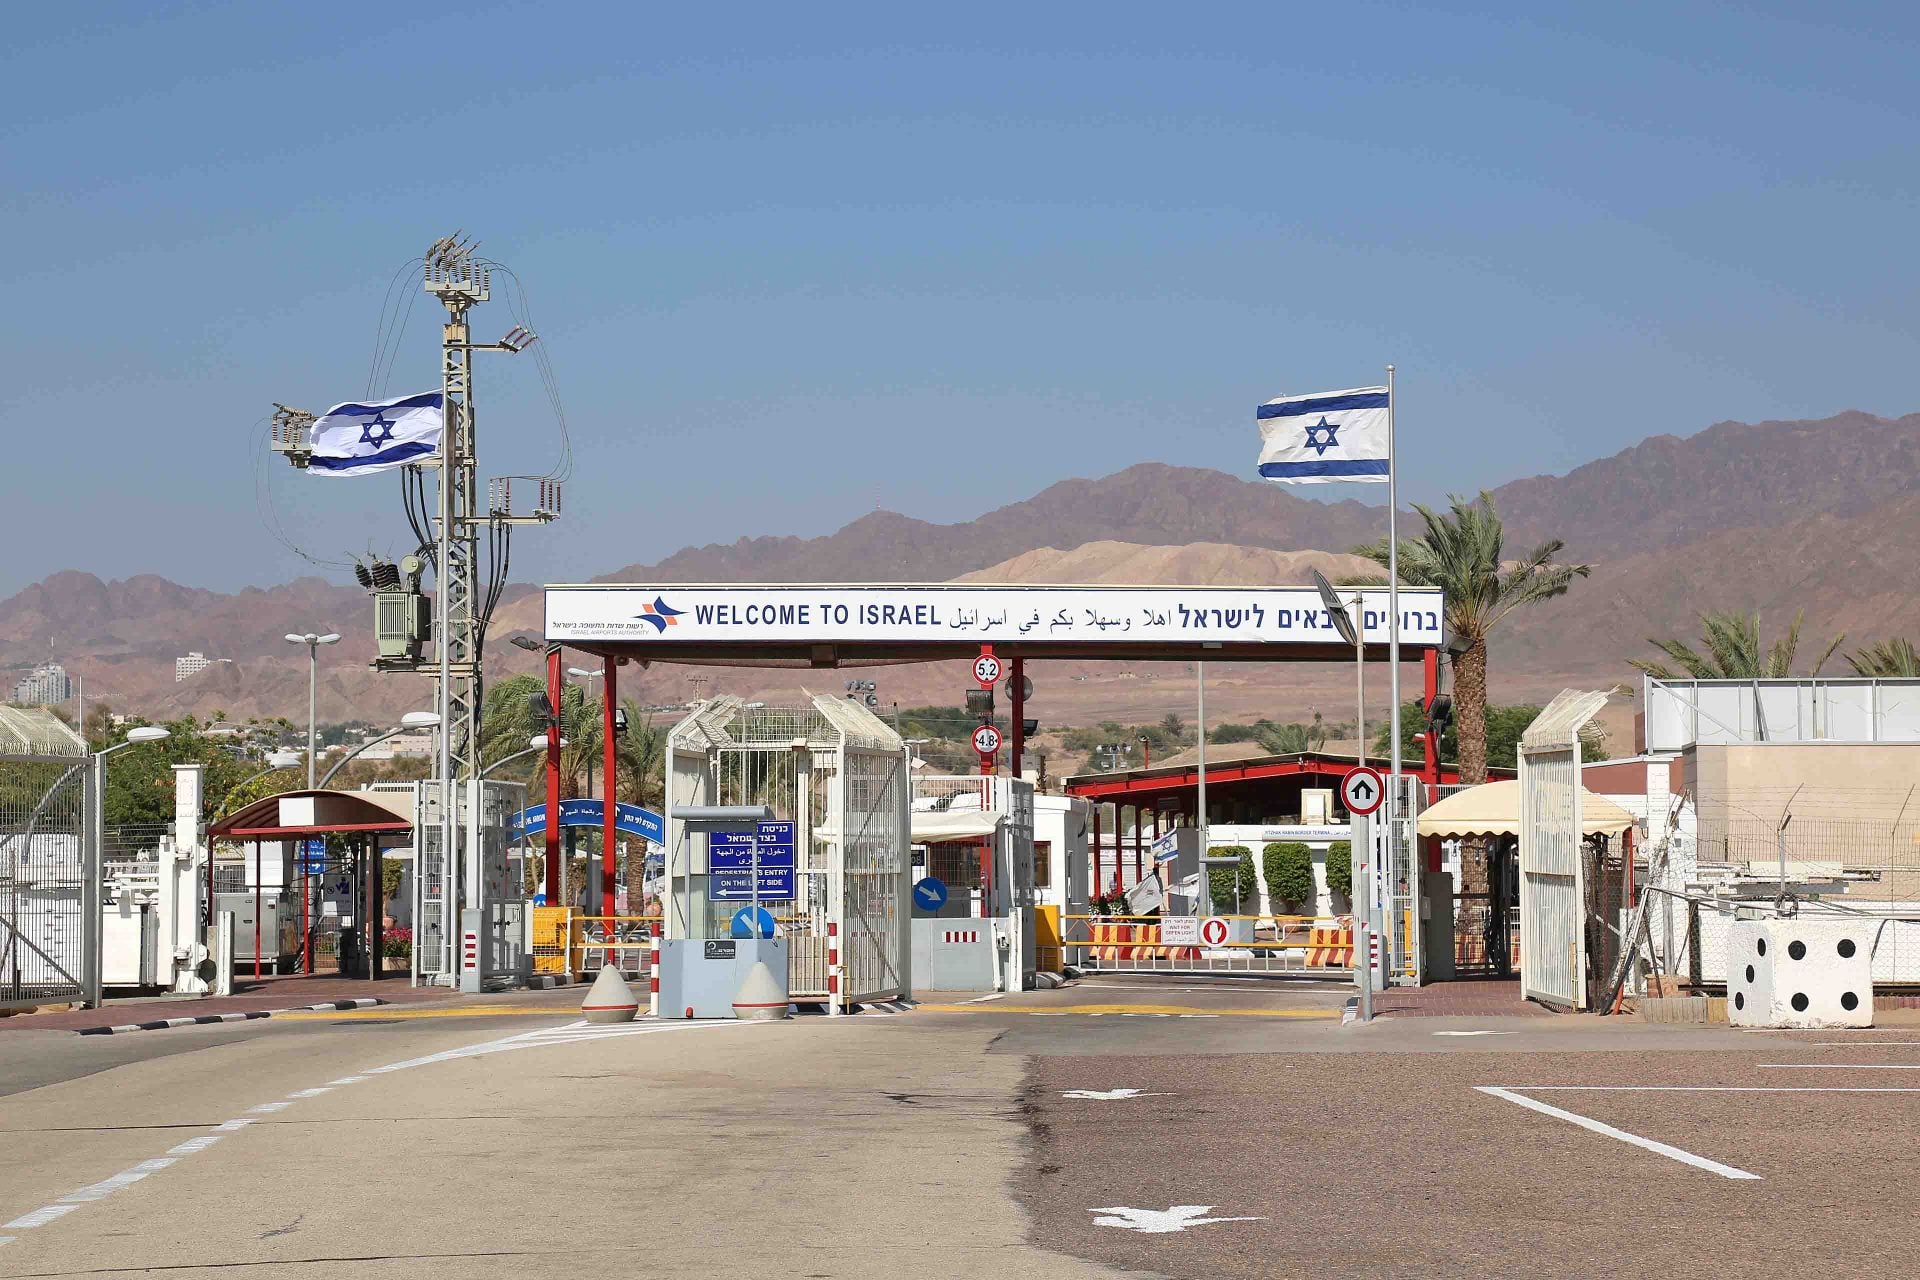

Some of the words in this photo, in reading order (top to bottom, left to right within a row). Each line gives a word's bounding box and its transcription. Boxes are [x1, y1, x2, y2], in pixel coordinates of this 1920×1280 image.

[695, 604, 810, 625] WELCOME
[819, 604, 849, 625] TO
[859, 604, 942, 625] ISRAEL
[949, 608, 1007, 631] اسرائيل
[1018, 608, 1040, 635] في
[1050, 608, 1074, 634] بكم
[1085, 608, 1131, 631] وسهلا
[1143, 608, 1171, 628] اهلا
[1178, 603, 1265, 629] לישראל
[1278, 608, 1337, 629] באים
[1363, 610, 1438, 631] ברוים
[978, 663, 997, 676] 5.2
[978, 735, 995, 747] 4.8
[758, 834, 777, 842] בצד
[761, 825, 789, 833] כניסת
[735, 849, 746, 857] من
[733, 879, 747, 887] THE
[747, 879, 766, 887] LFT
